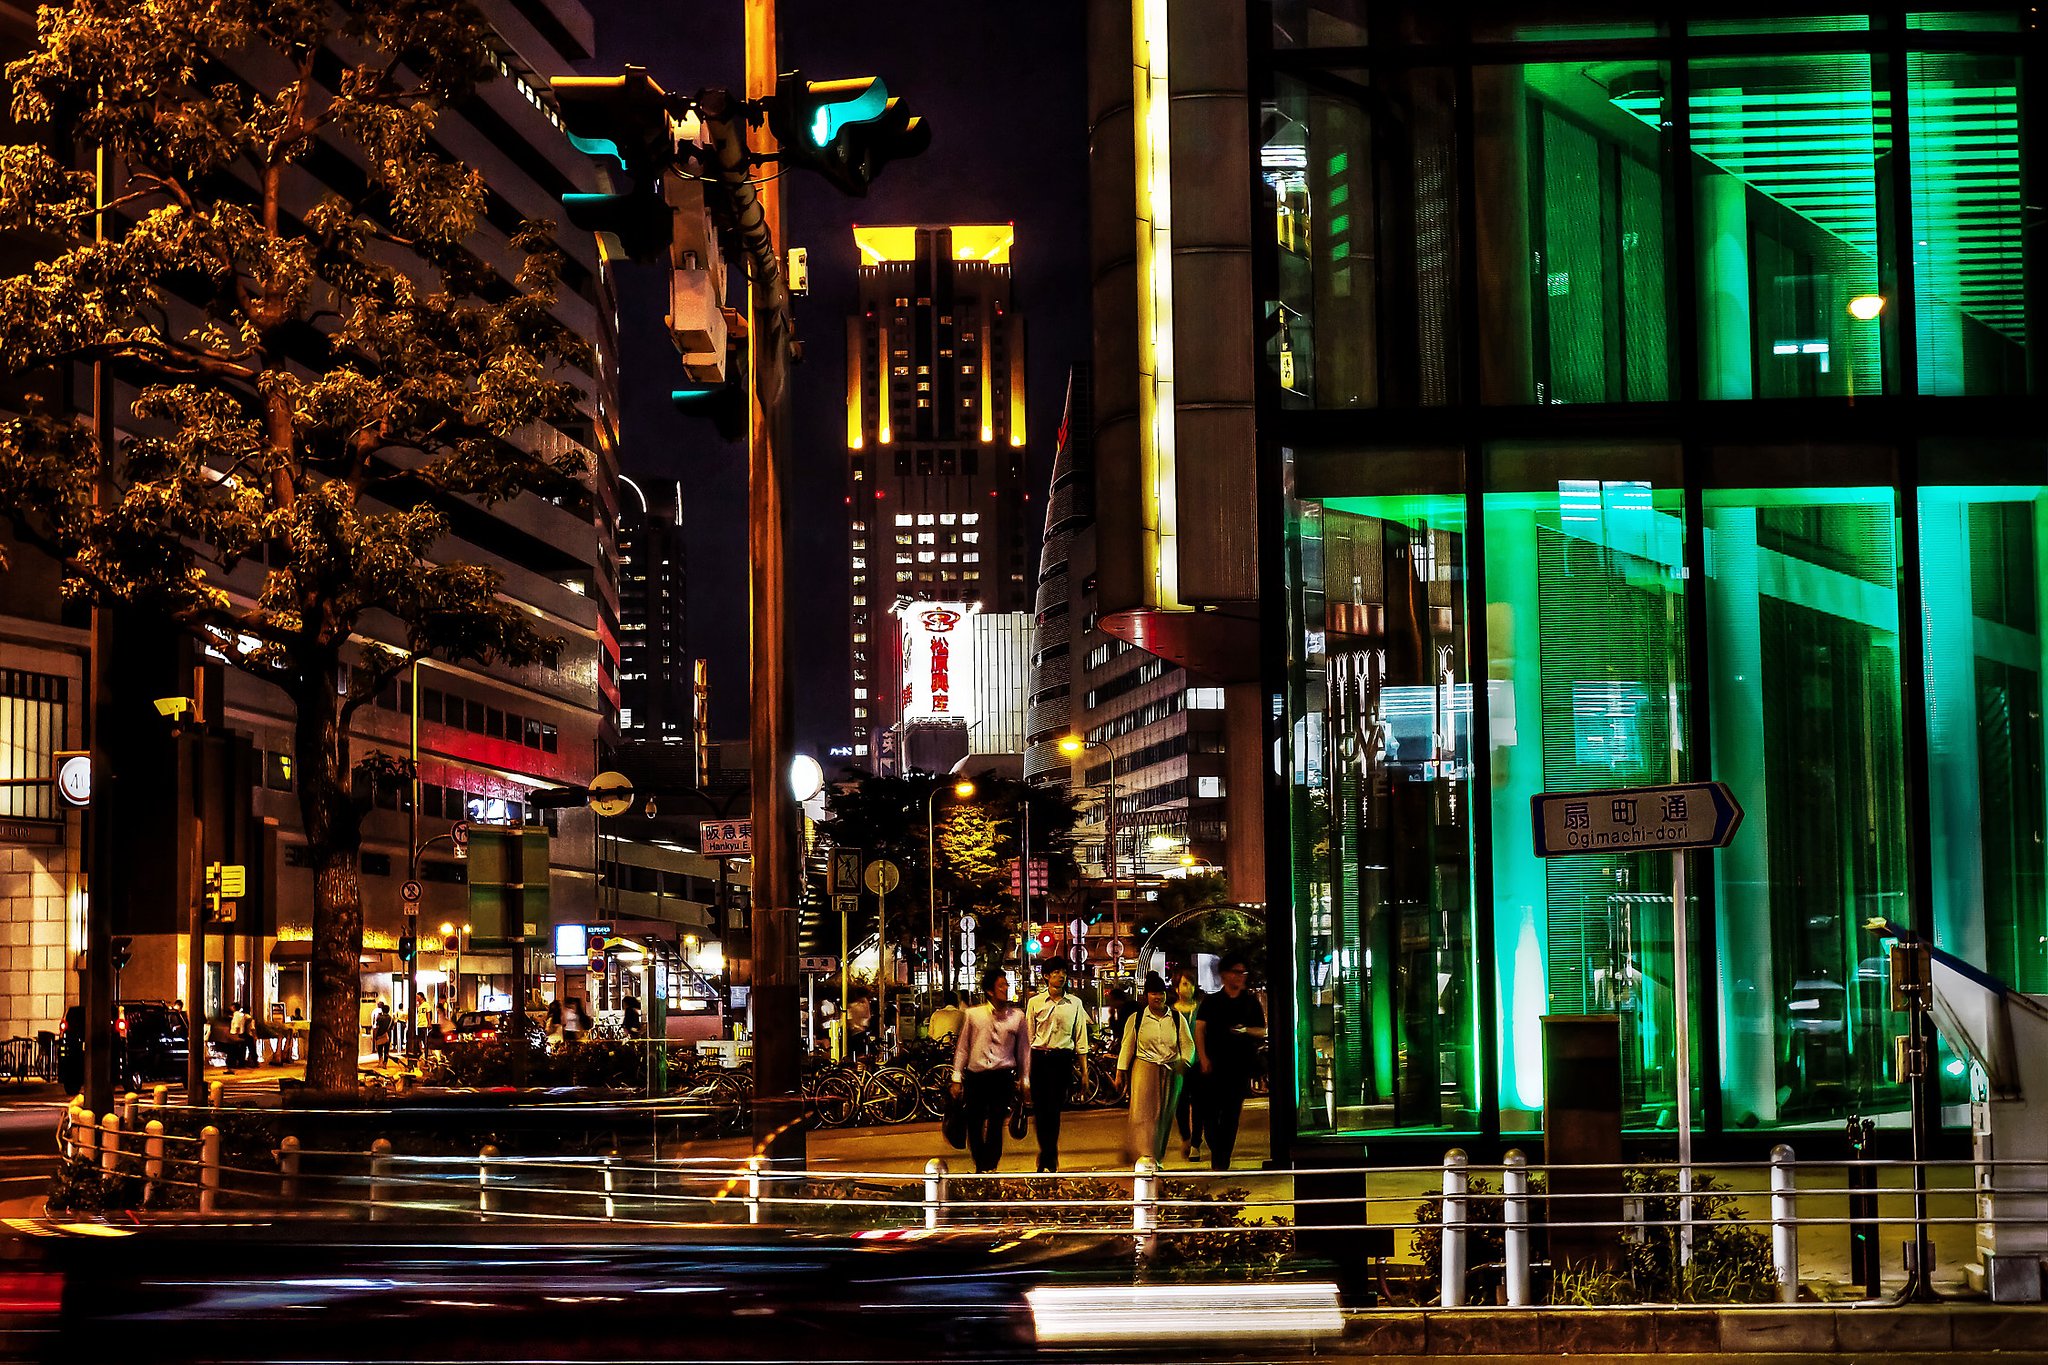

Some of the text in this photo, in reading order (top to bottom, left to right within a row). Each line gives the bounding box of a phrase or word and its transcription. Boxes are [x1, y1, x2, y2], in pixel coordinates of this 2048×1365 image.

[1563, 794, 1689, 830] 扇町通
[705, 823, 752, 840] 阪急東
[1566, 823, 1689, 848] Ogimachi-dori
[709, 841, 740, 852] Hankyu
